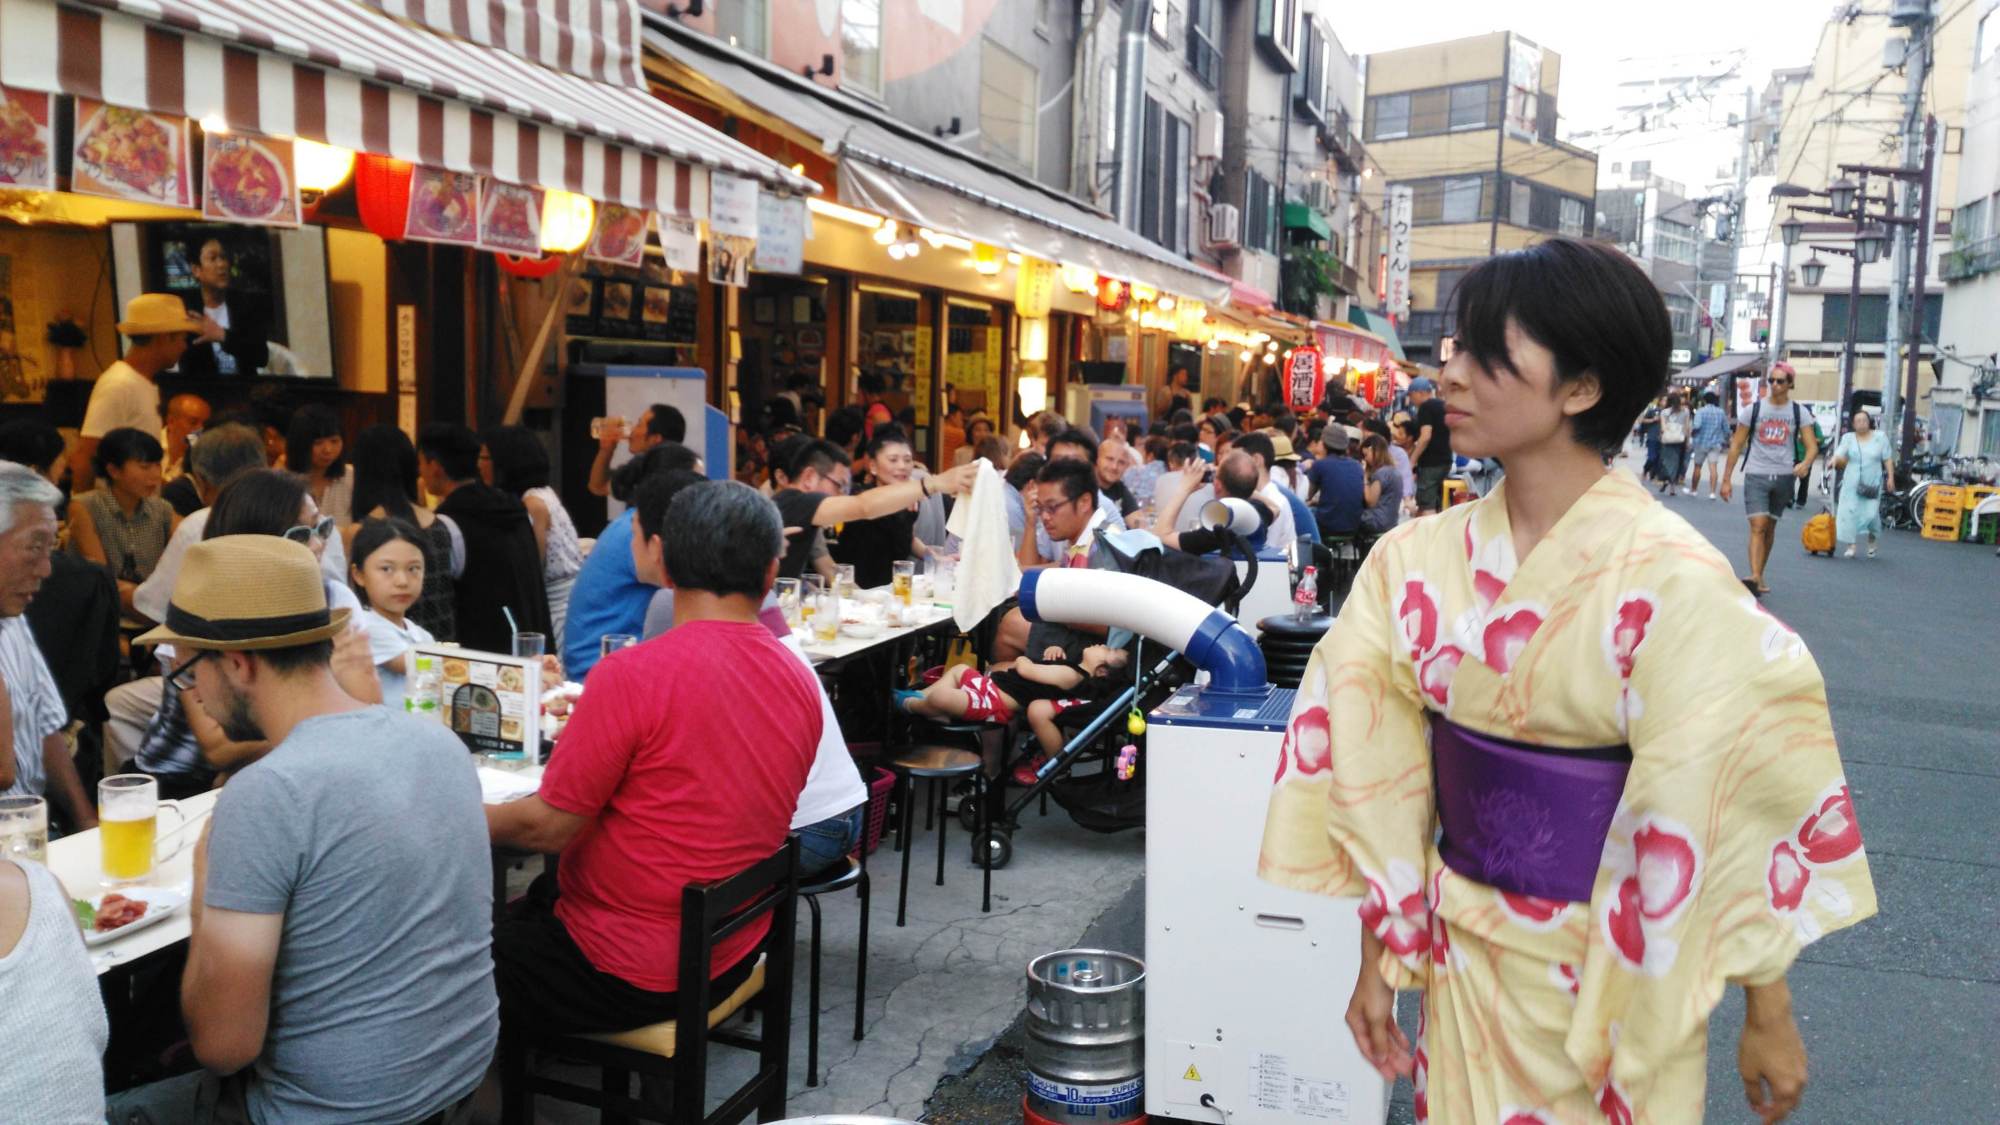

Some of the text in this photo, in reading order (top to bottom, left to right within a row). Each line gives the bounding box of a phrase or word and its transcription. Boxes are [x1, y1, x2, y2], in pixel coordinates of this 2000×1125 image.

[1292, 353, 1312, 406] 居酒屋
[1111, 1081, 1136, 1094] SUPER
